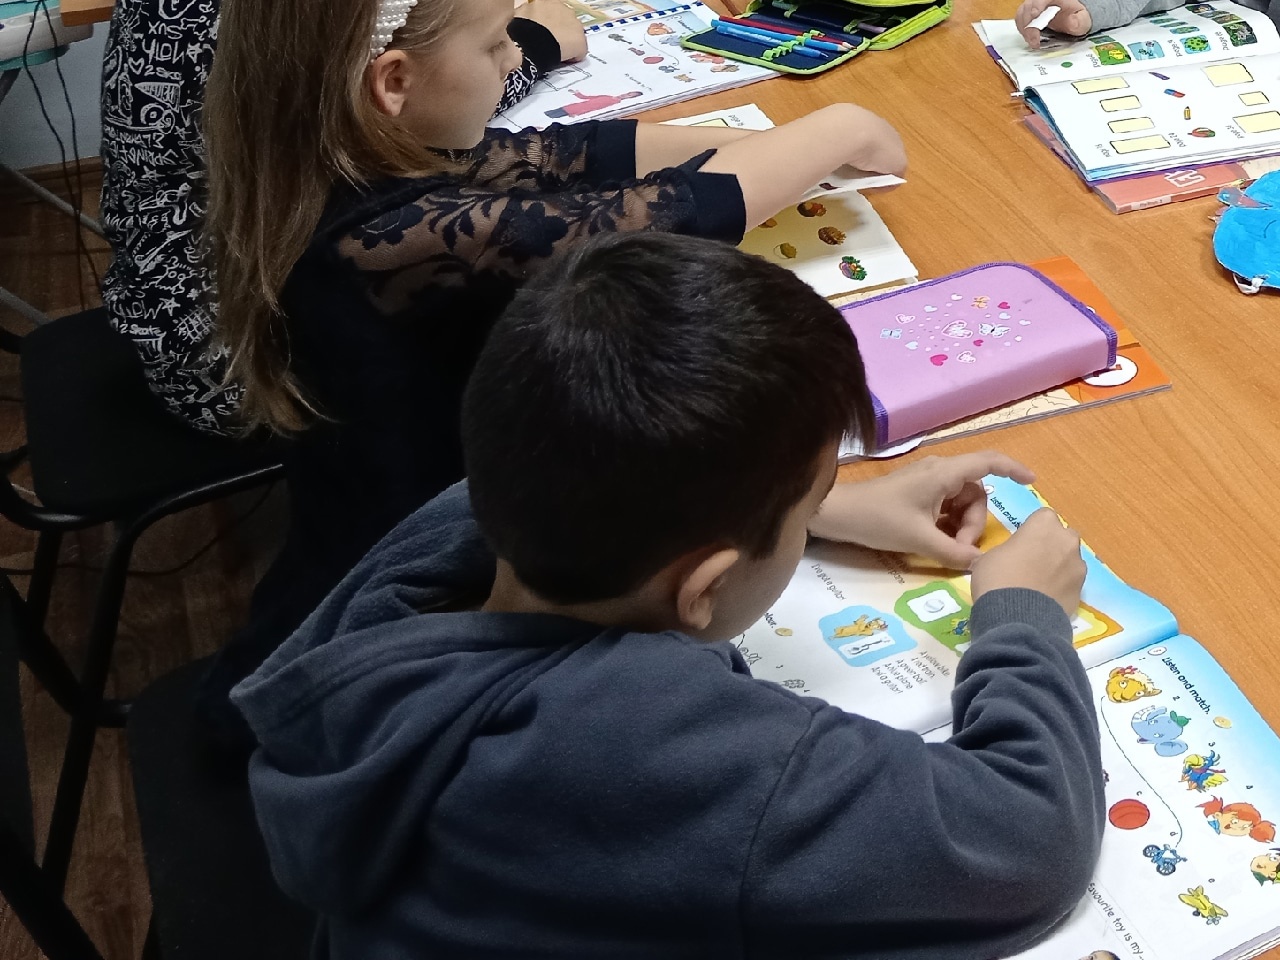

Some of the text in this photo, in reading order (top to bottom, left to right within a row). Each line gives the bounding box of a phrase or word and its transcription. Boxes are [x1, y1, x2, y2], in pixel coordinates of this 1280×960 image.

[1162, 657, 1211, 715] Listen and match.
[1112, 917, 1127, 932] toy
[1123, 932, 1133, 942] is
